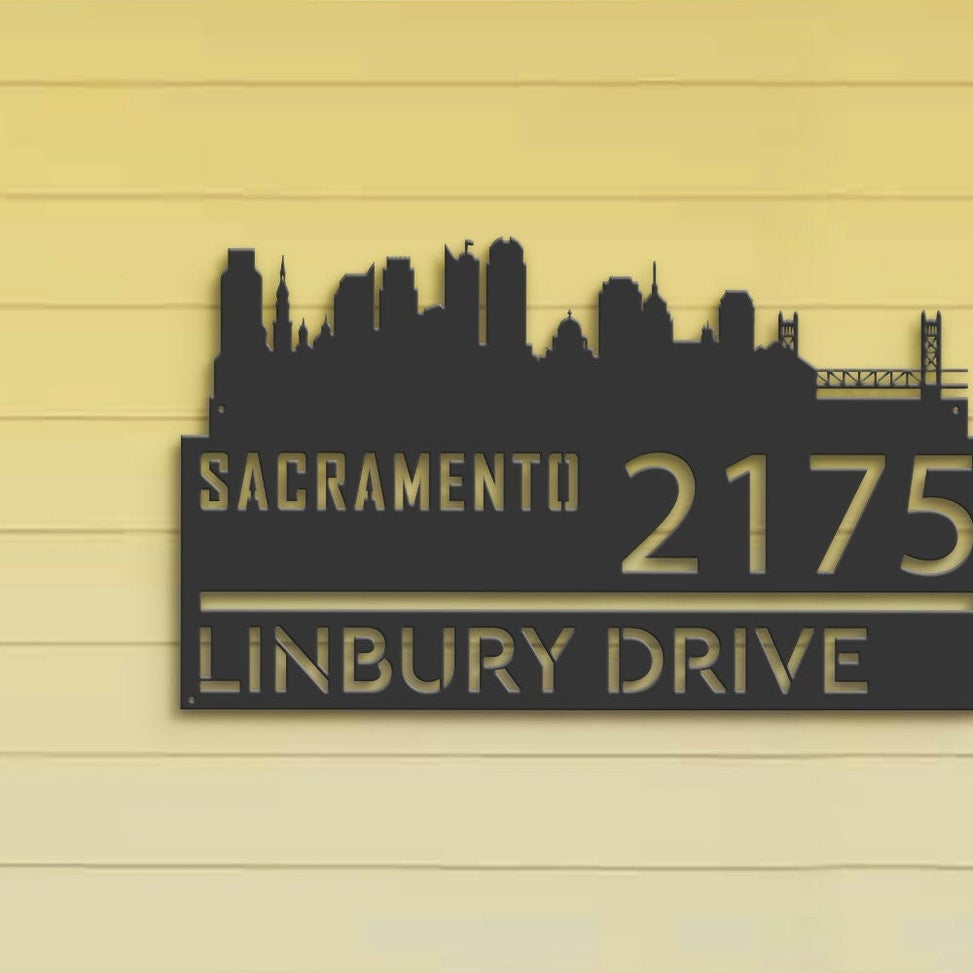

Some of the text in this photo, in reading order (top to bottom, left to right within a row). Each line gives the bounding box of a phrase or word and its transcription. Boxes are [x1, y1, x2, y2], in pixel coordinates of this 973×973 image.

[200, 452, 579, 512] SACRAMENTO
[200, 627, 869, 695] LINBURY DRIVE
